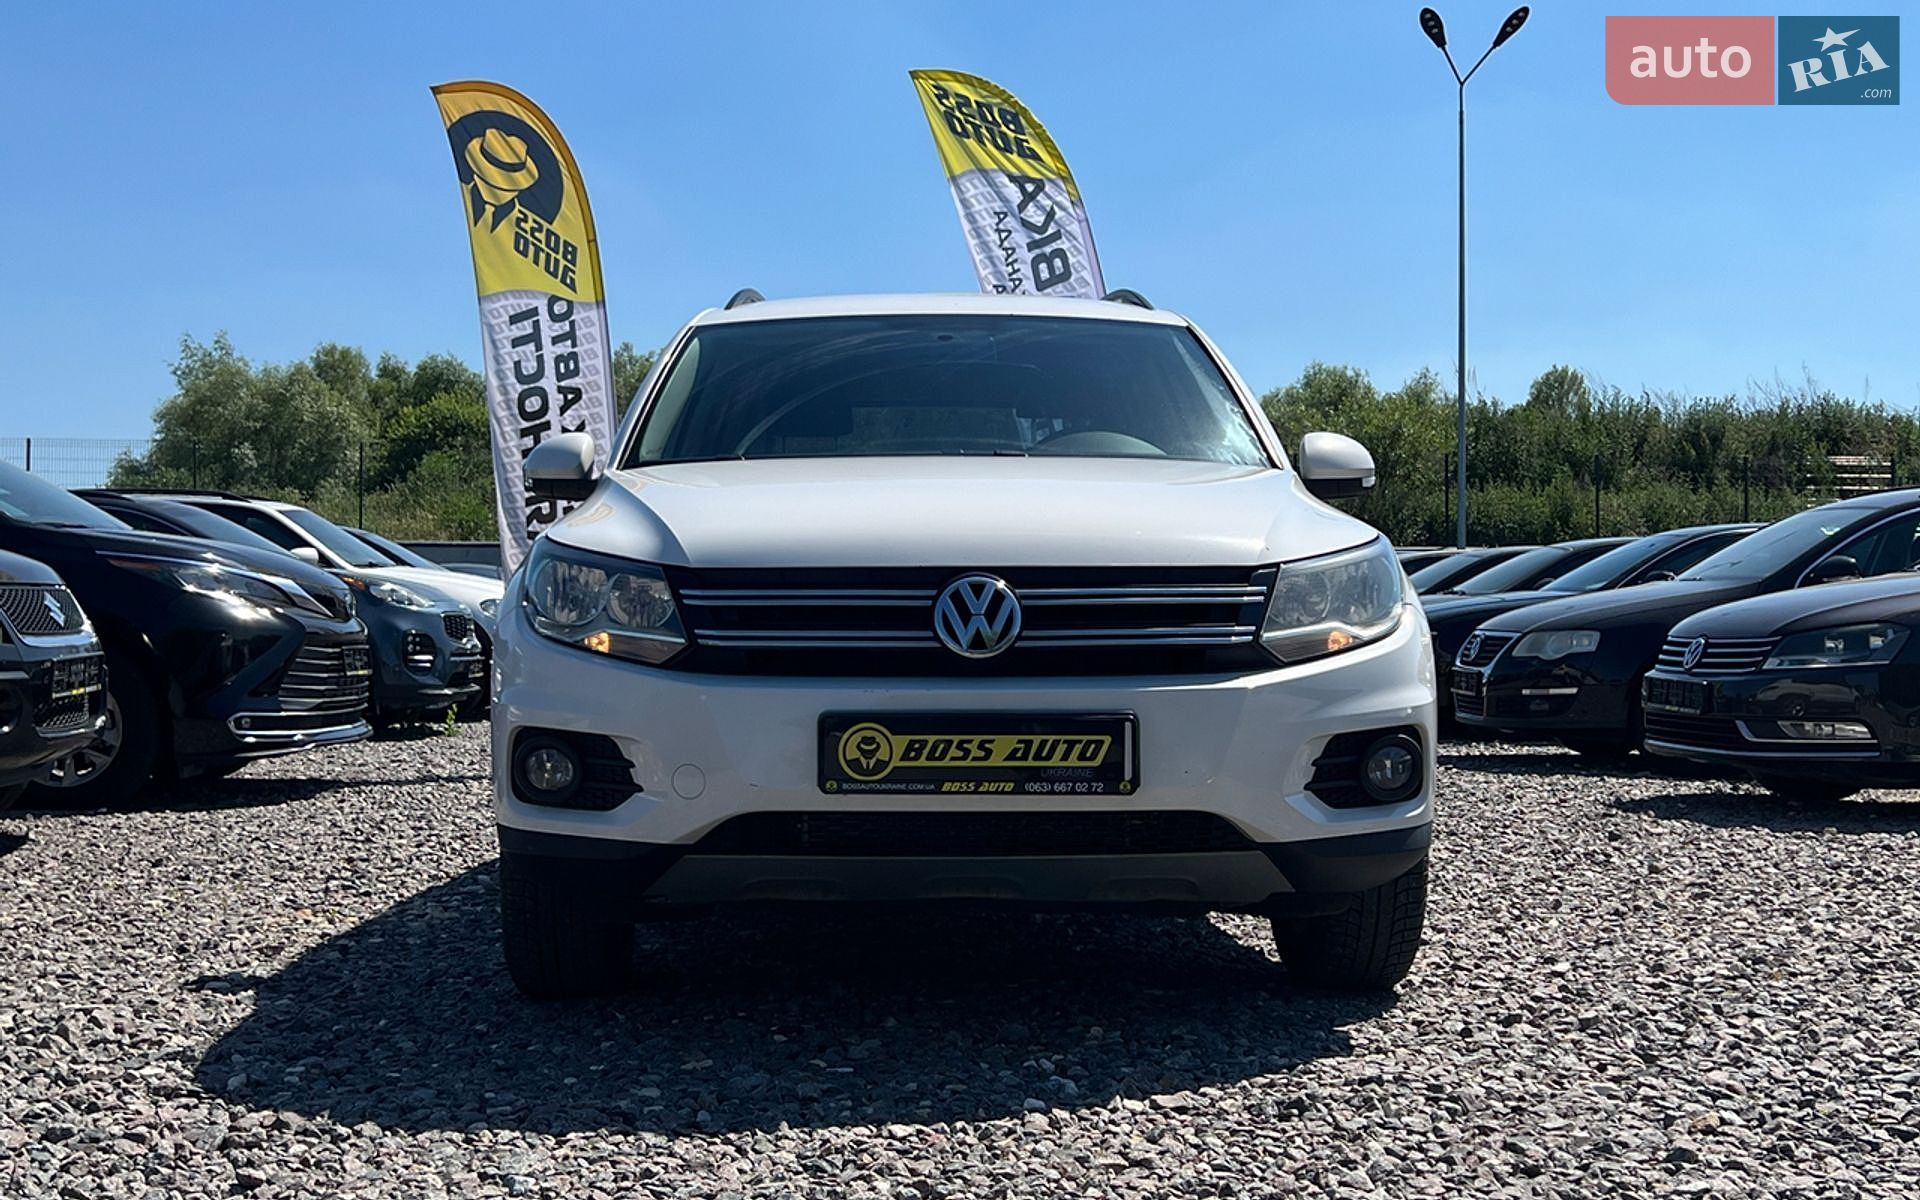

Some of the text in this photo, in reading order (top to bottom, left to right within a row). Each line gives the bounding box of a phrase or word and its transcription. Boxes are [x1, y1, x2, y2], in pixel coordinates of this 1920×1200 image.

[898, 738, 1107, 762] BOSS AUTO
[1040, 767, 1095, 778] UKRAINE
[940, 782, 1015, 792] BOSS AUTO
[1024, 781, 1104, 793] (063) 667 02 72
